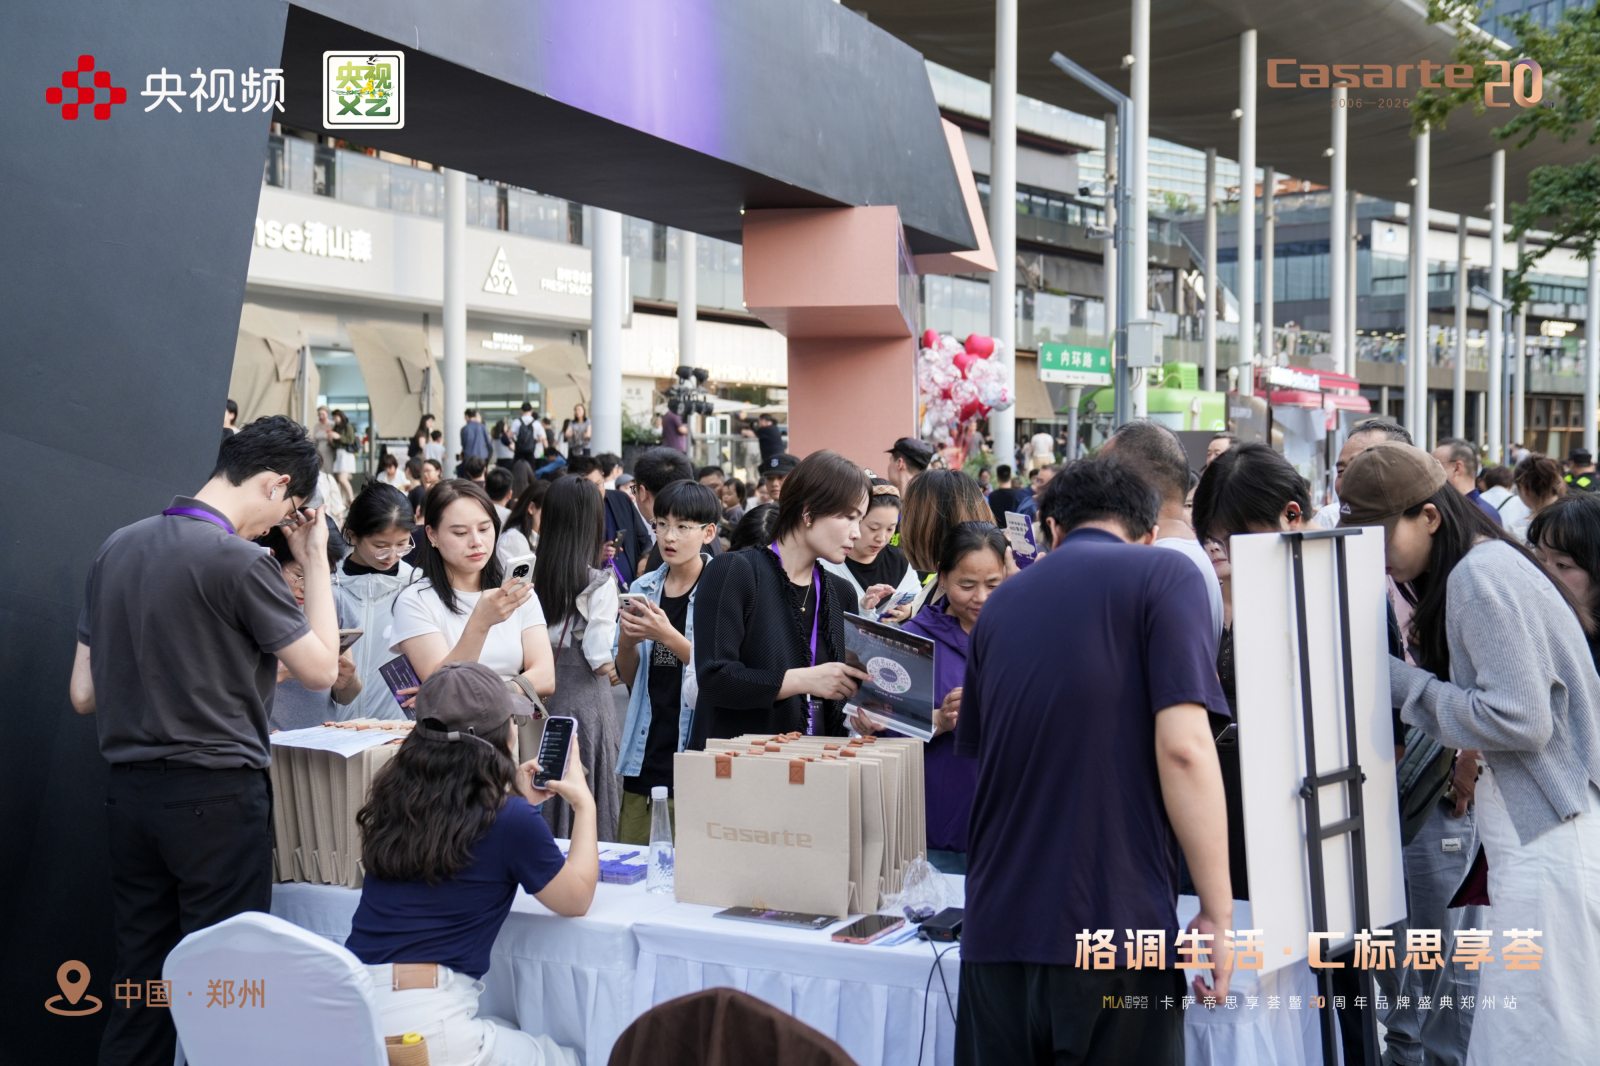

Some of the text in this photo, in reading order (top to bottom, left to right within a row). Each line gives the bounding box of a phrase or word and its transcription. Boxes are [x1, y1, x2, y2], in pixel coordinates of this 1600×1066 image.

[1060, 348, 1093, 368] 内环路
[706, 821, 813, 849] Casarte
